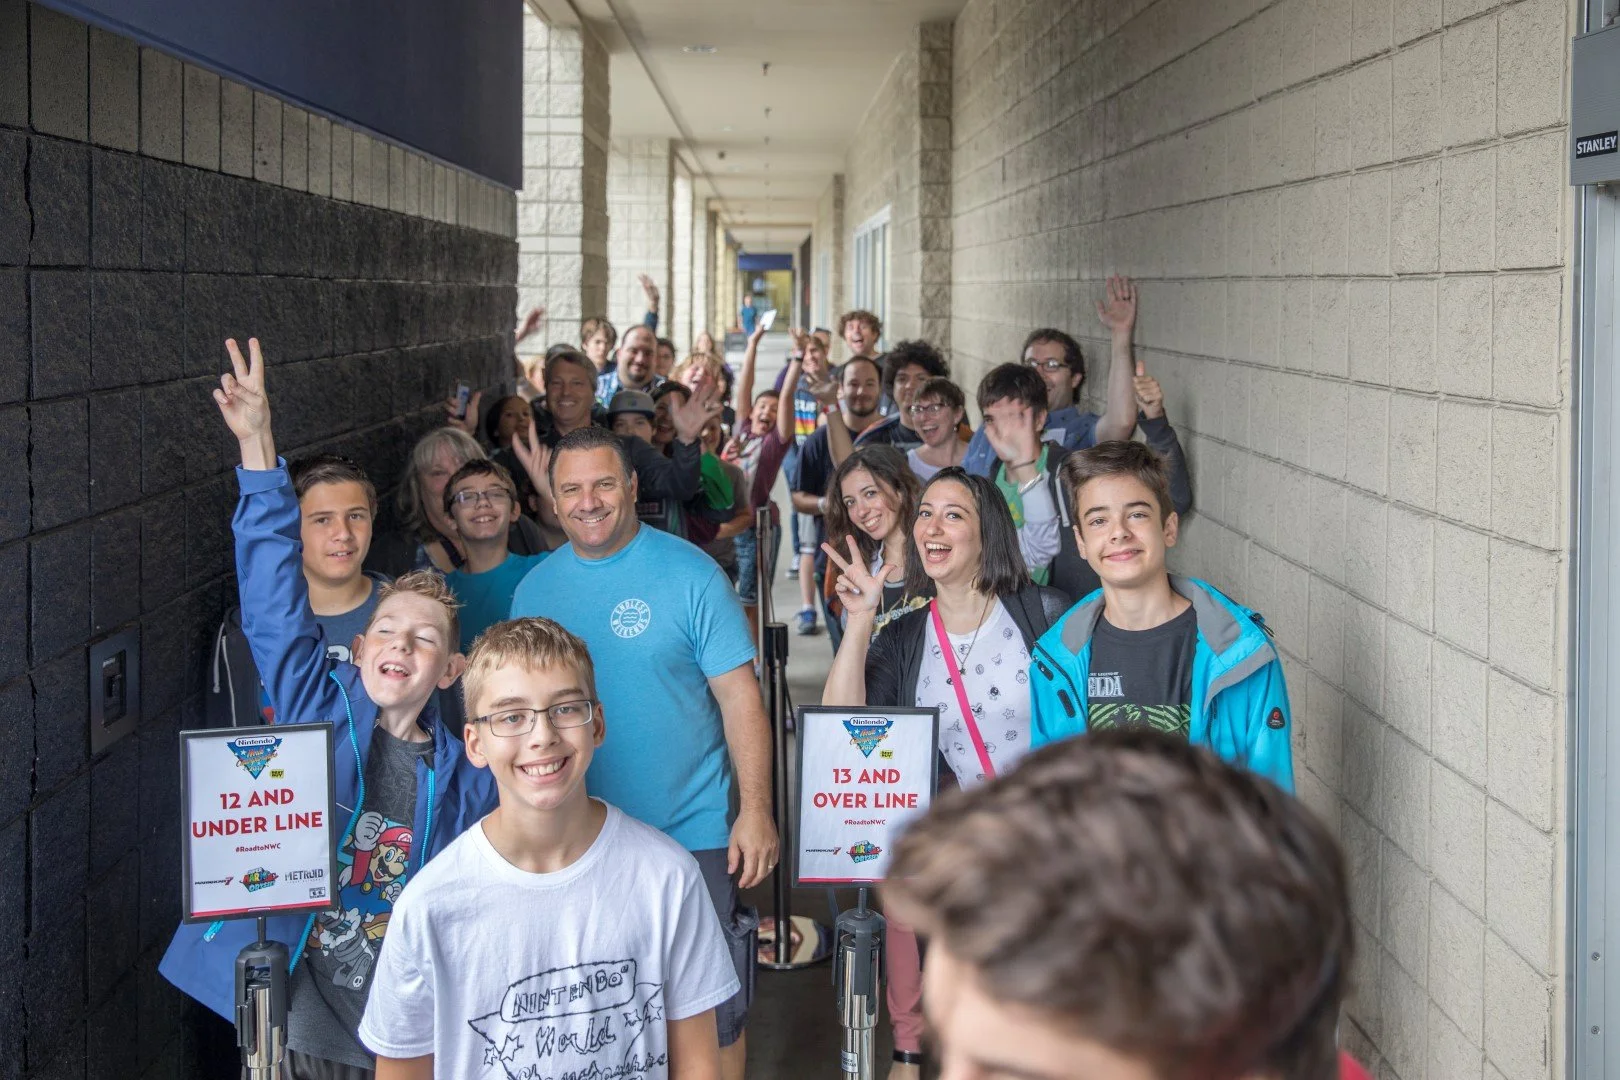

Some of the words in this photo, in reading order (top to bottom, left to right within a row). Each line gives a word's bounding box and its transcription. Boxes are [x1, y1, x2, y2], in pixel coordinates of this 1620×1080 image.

[1577, 136, 1617, 155] STANLEY
[614, 601, 648, 614] ENDLESS
[1088, 675, 1125, 698] ELDA
[238, 738, 273, 746] Nintendo
[832, 768, 851, 784] 13
[858, 768, 901, 784] AND
[219, 792, 241, 810] 12
[248, 788, 294, 808] AND
[813, 793, 867, 809] OVER
[874, 793, 918, 809] LINE
[192, 815, 267, 839] UNDER
[275, 811, 323, 831] LINE
[235, 842, 281, 853] #RoadtoNWC
[285, 868, 324, 881] METROID
[536, 1016, 616, 1059] World
